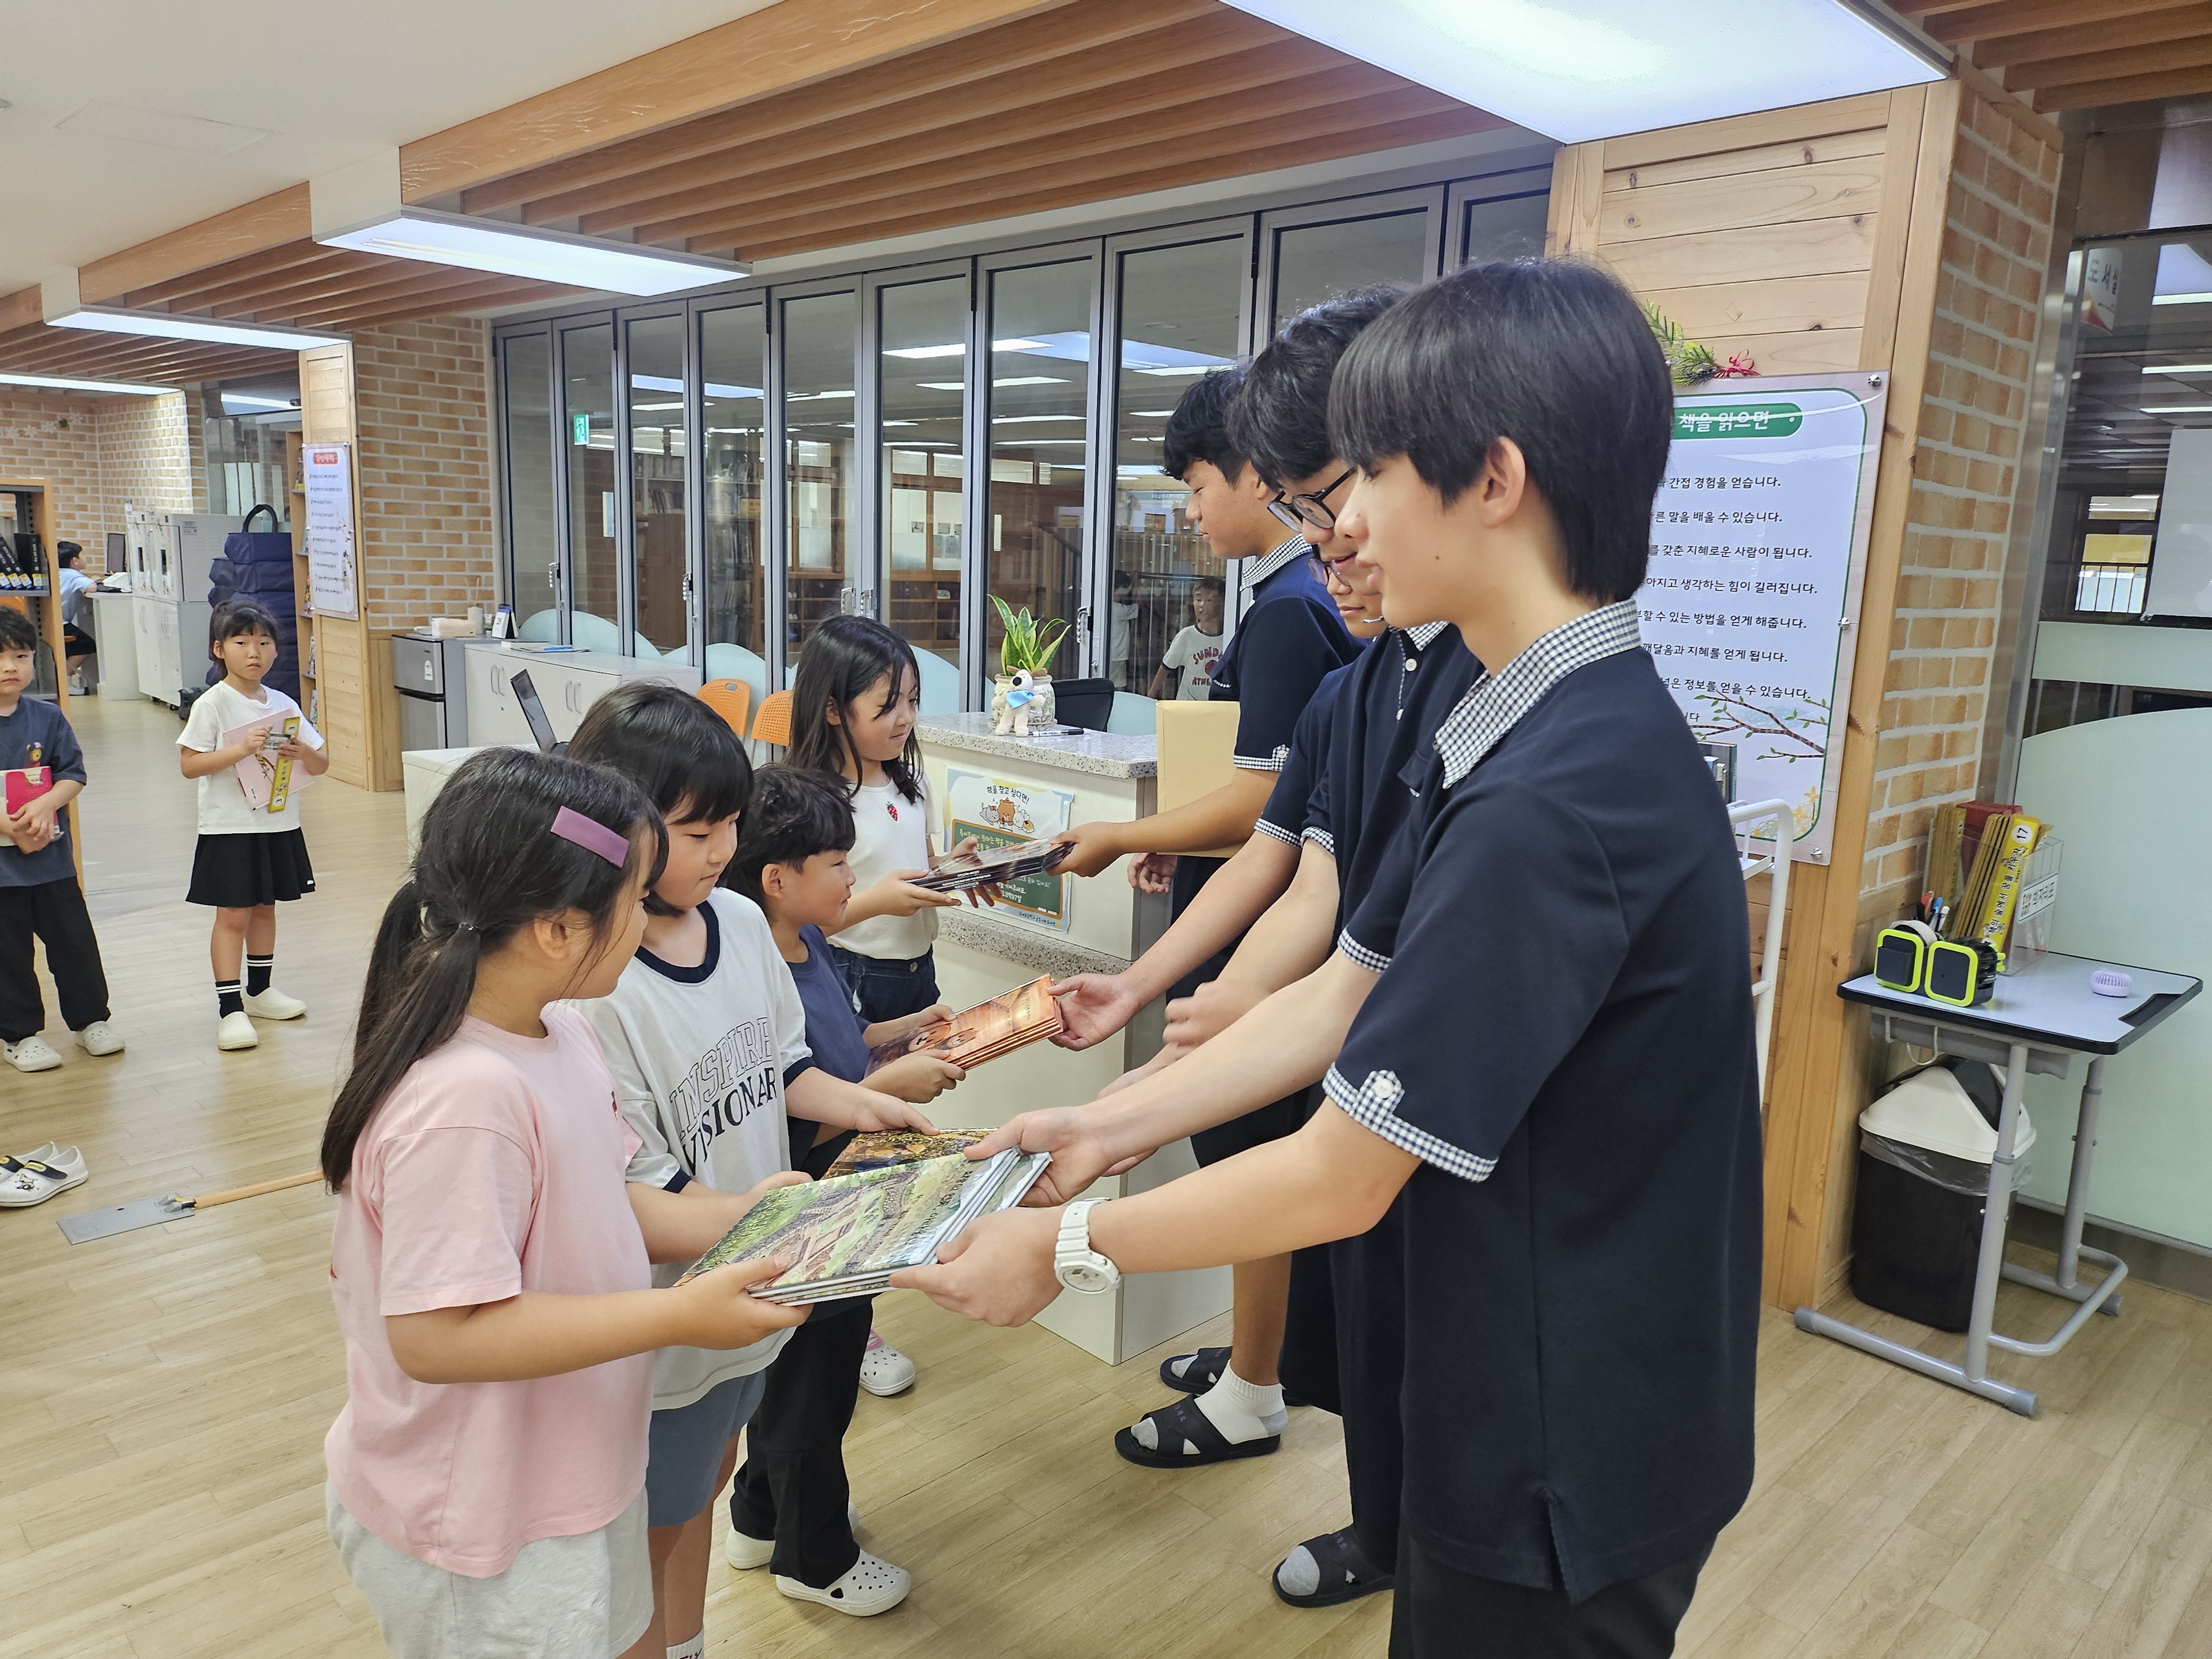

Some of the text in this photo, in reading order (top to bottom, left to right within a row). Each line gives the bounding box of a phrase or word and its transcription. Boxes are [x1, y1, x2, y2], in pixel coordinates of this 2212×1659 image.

[1678, 410, 1770, 432] 책을 읽으면
[1669, 477, 1691, 489] 간접
[1694, 477, 1728, 489] 경험을
[1731, 477, 1781, 489] 얻습니다.
[1669, 512, 1690, 523] 말을
[1693, 512, 1715, 523] 배울
[1718, 512, 1729, 523] 수
[1733, 512, 1782, 524] 있습니다.
[1663, 545, 1684, 556] 갖춘
[1687, 545, 1731, 557] 지혜로운
[1734, 546, 1769, 559] 사람이
[1772, 547, 1812, 559] 됩니다.
[1646, 578, 1818, 594] 아지고 생각하는 힘이 길러집니다.
[1656, 611, 1666, 622] 수
[1670, 612, 1691, 624] 있는
[1694, 613, 1726, 626] 방법을
[1730, 615, 1752, 627] 얻게
[1755, 616, 1807, 629] 해줍니다.
[1642, 643, 1787, 662] 깨달음과 지혜를 얻게 됩니다.
[1192, 677, 1211, 686] ATHL
[1684, 679, 1716, 692] 정보를
[1720, 682, 1743, 695] 얻을
[1745, 685, 1756, 696] 수
[1760, 686, 1811, 698] 있습니다.
[987, 785, 1029, 804] 책을 찾고 싶다면!
[2017, 827, 2028, 839] 17
[670, 1017, 773, 1139] INSPIRE
[682, 1067, 778, 1176] VISIONAR
